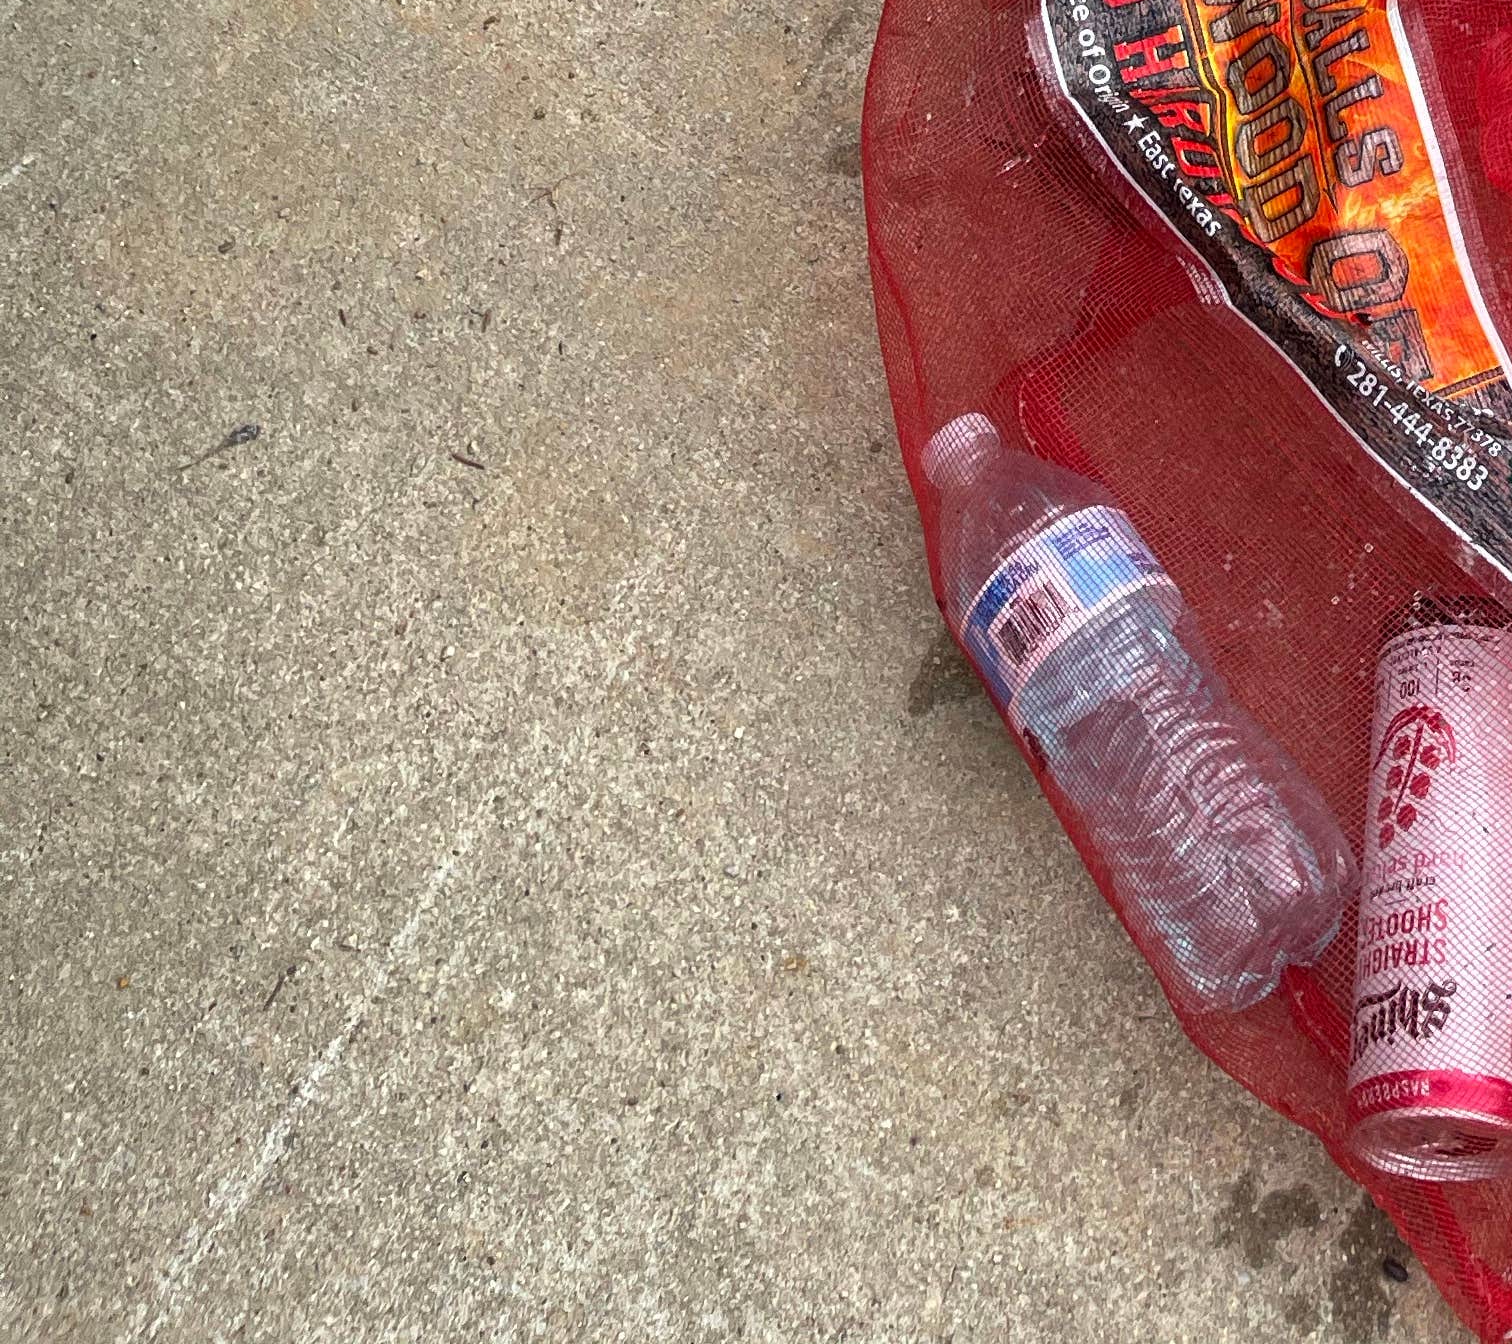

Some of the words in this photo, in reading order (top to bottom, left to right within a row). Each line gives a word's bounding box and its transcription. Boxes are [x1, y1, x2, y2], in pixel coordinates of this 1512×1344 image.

[1078, 28, 1104, 60] of
[1088, 63, 1130, 114] Origin
[1346, 361, 1489, 492] 281-444-8383
[1453, 415, 1502, 458] 77378
[1361, 897, 1449, 944] SHOOTE
[1358, 937, 1448, 980] STRAIGH
